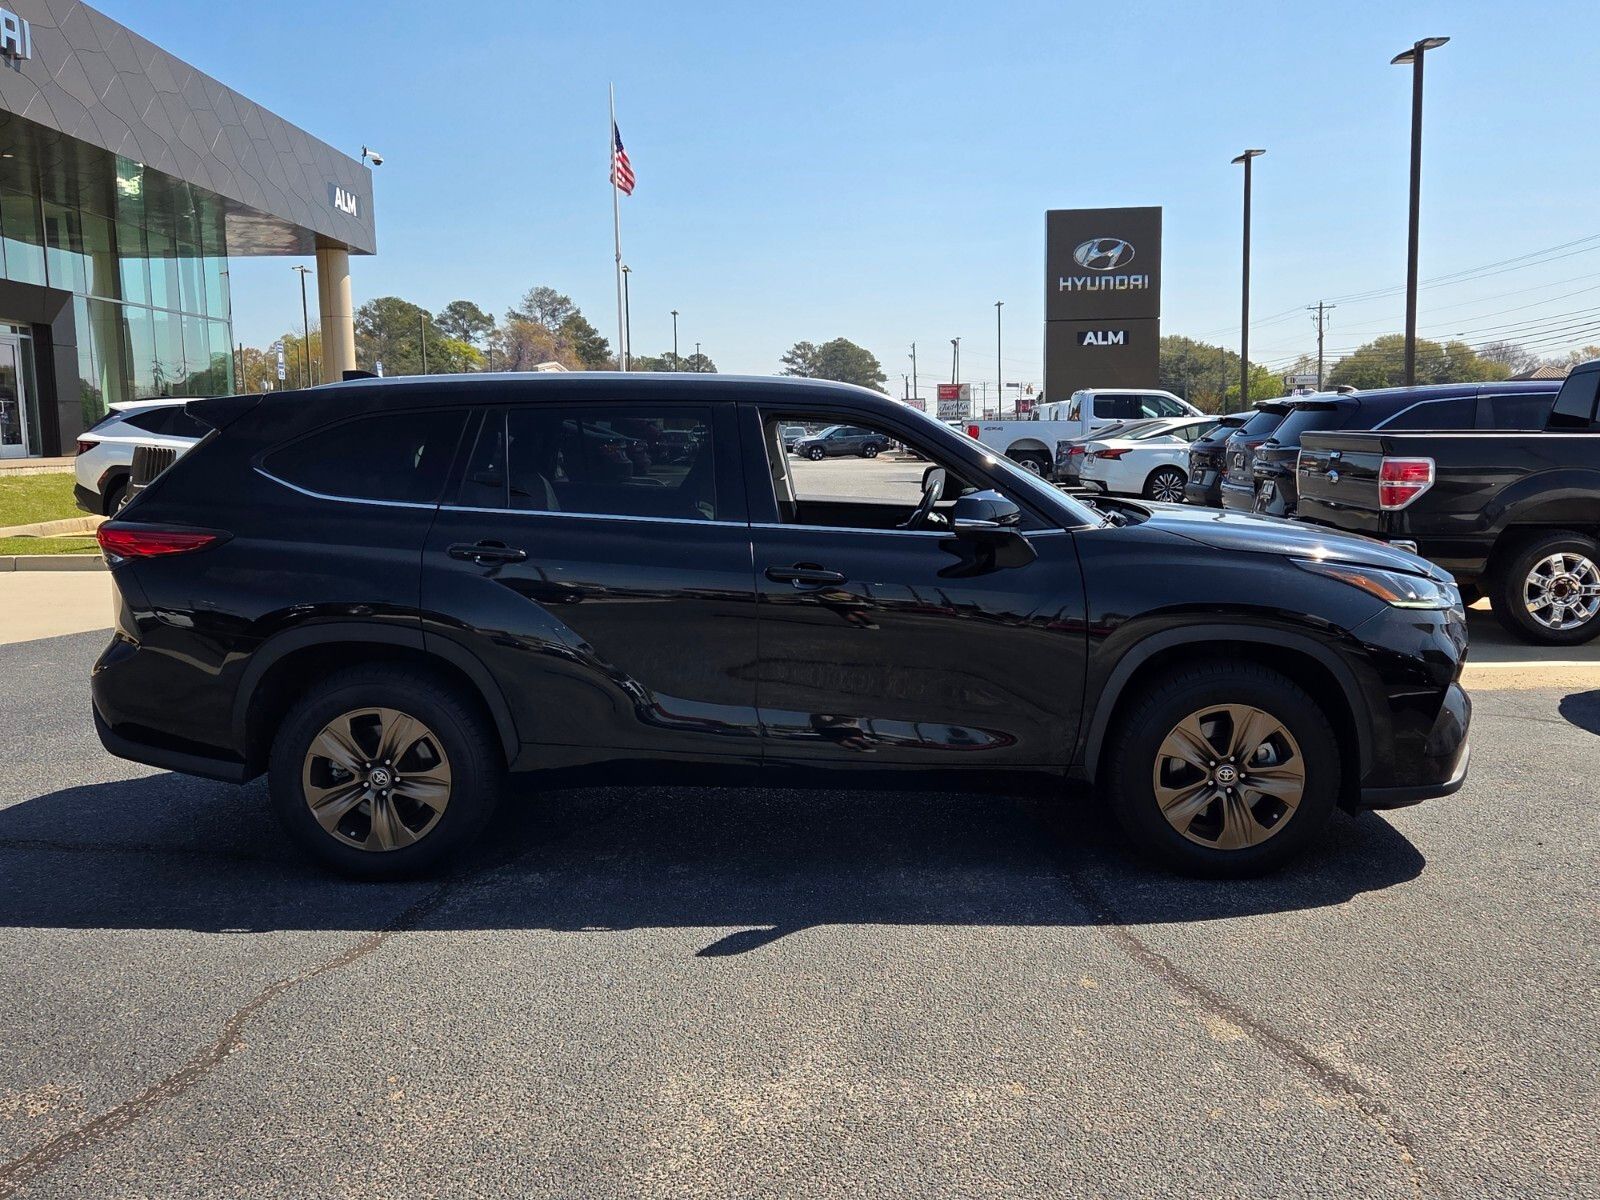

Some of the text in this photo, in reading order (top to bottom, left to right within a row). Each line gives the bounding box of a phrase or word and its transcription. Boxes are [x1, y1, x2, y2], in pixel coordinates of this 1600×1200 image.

[334, 186, 357, 217] ALM
[1059, 275, 1149, 291] HYUNDAI
[1082, 331, 1124, 346] ALM
